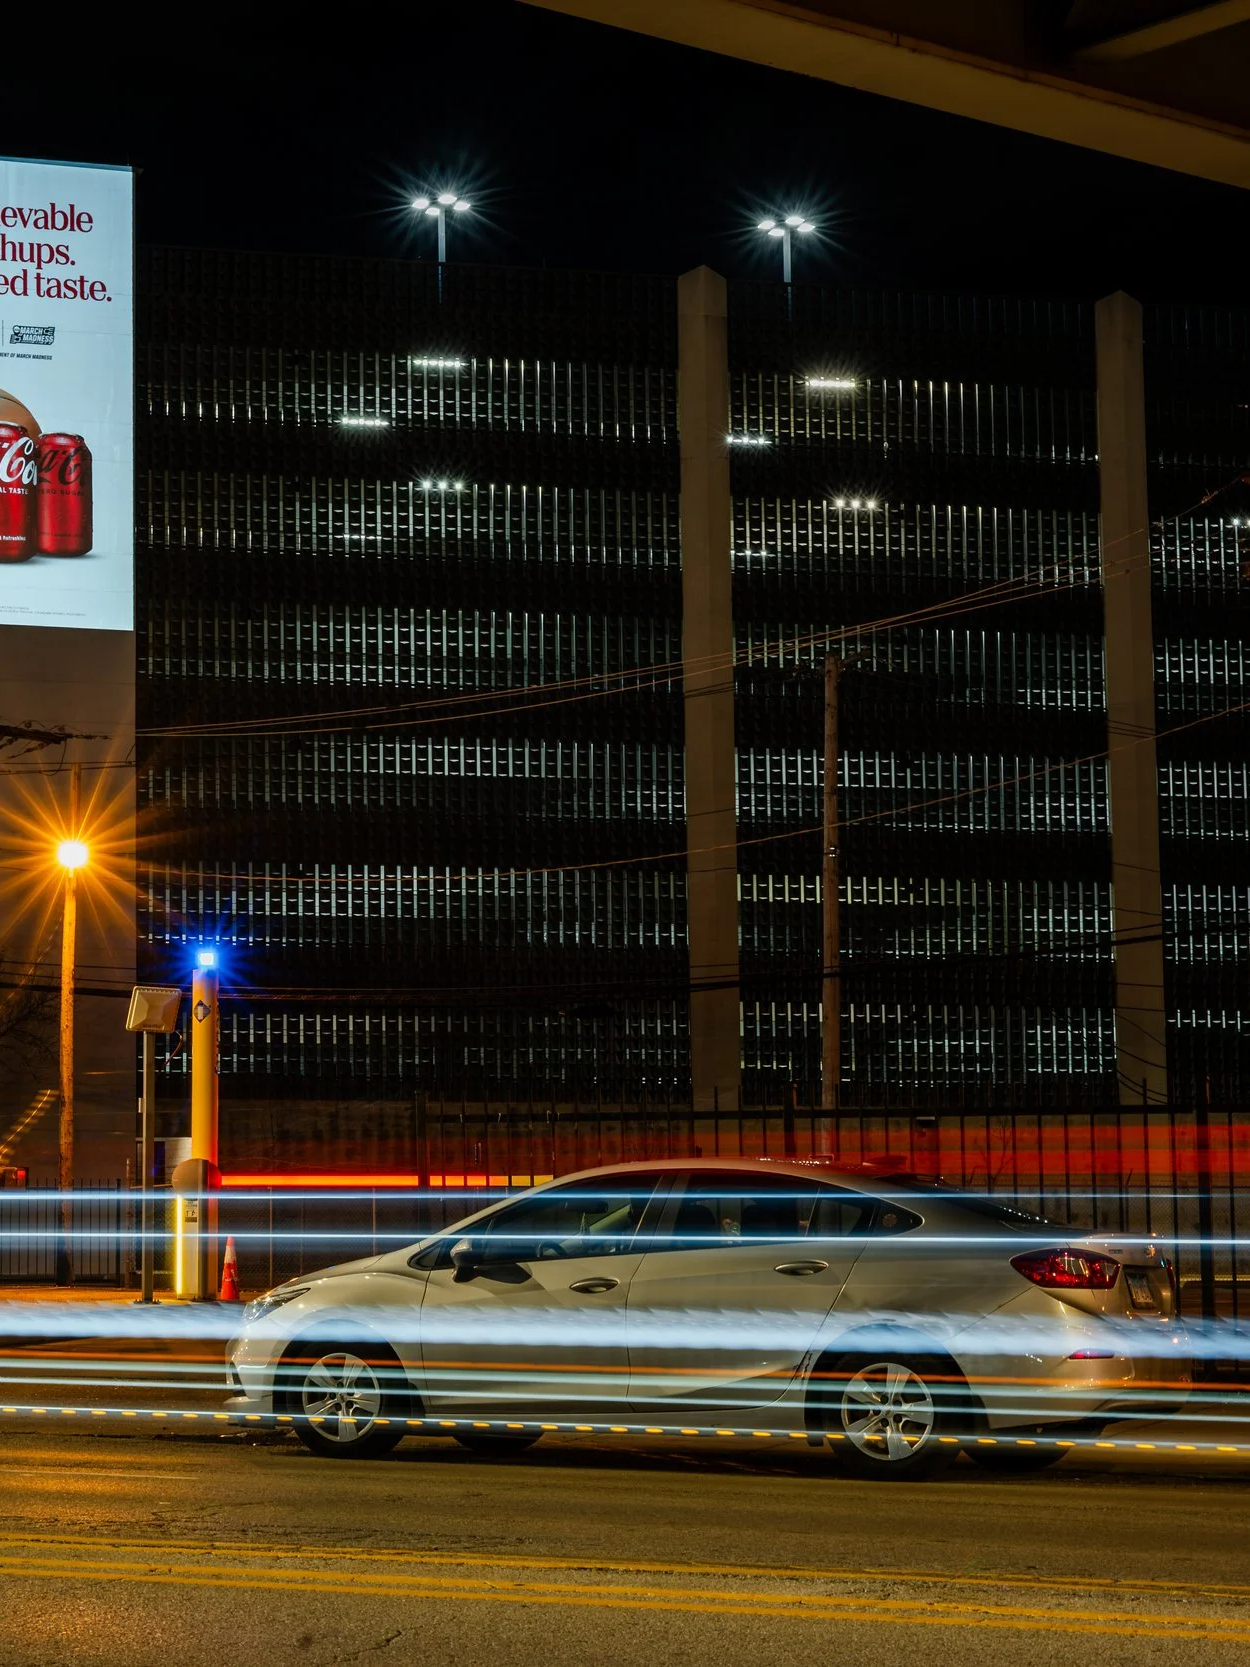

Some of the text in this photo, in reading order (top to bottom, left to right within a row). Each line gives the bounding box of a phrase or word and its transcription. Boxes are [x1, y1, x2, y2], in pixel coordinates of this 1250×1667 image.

[34, 272, 112, 302] taste.
[19, 326, 43, 335] MARCH
[22, 334, 54, 343] MADNESS
[8, 487, 29, 495] TASTE
